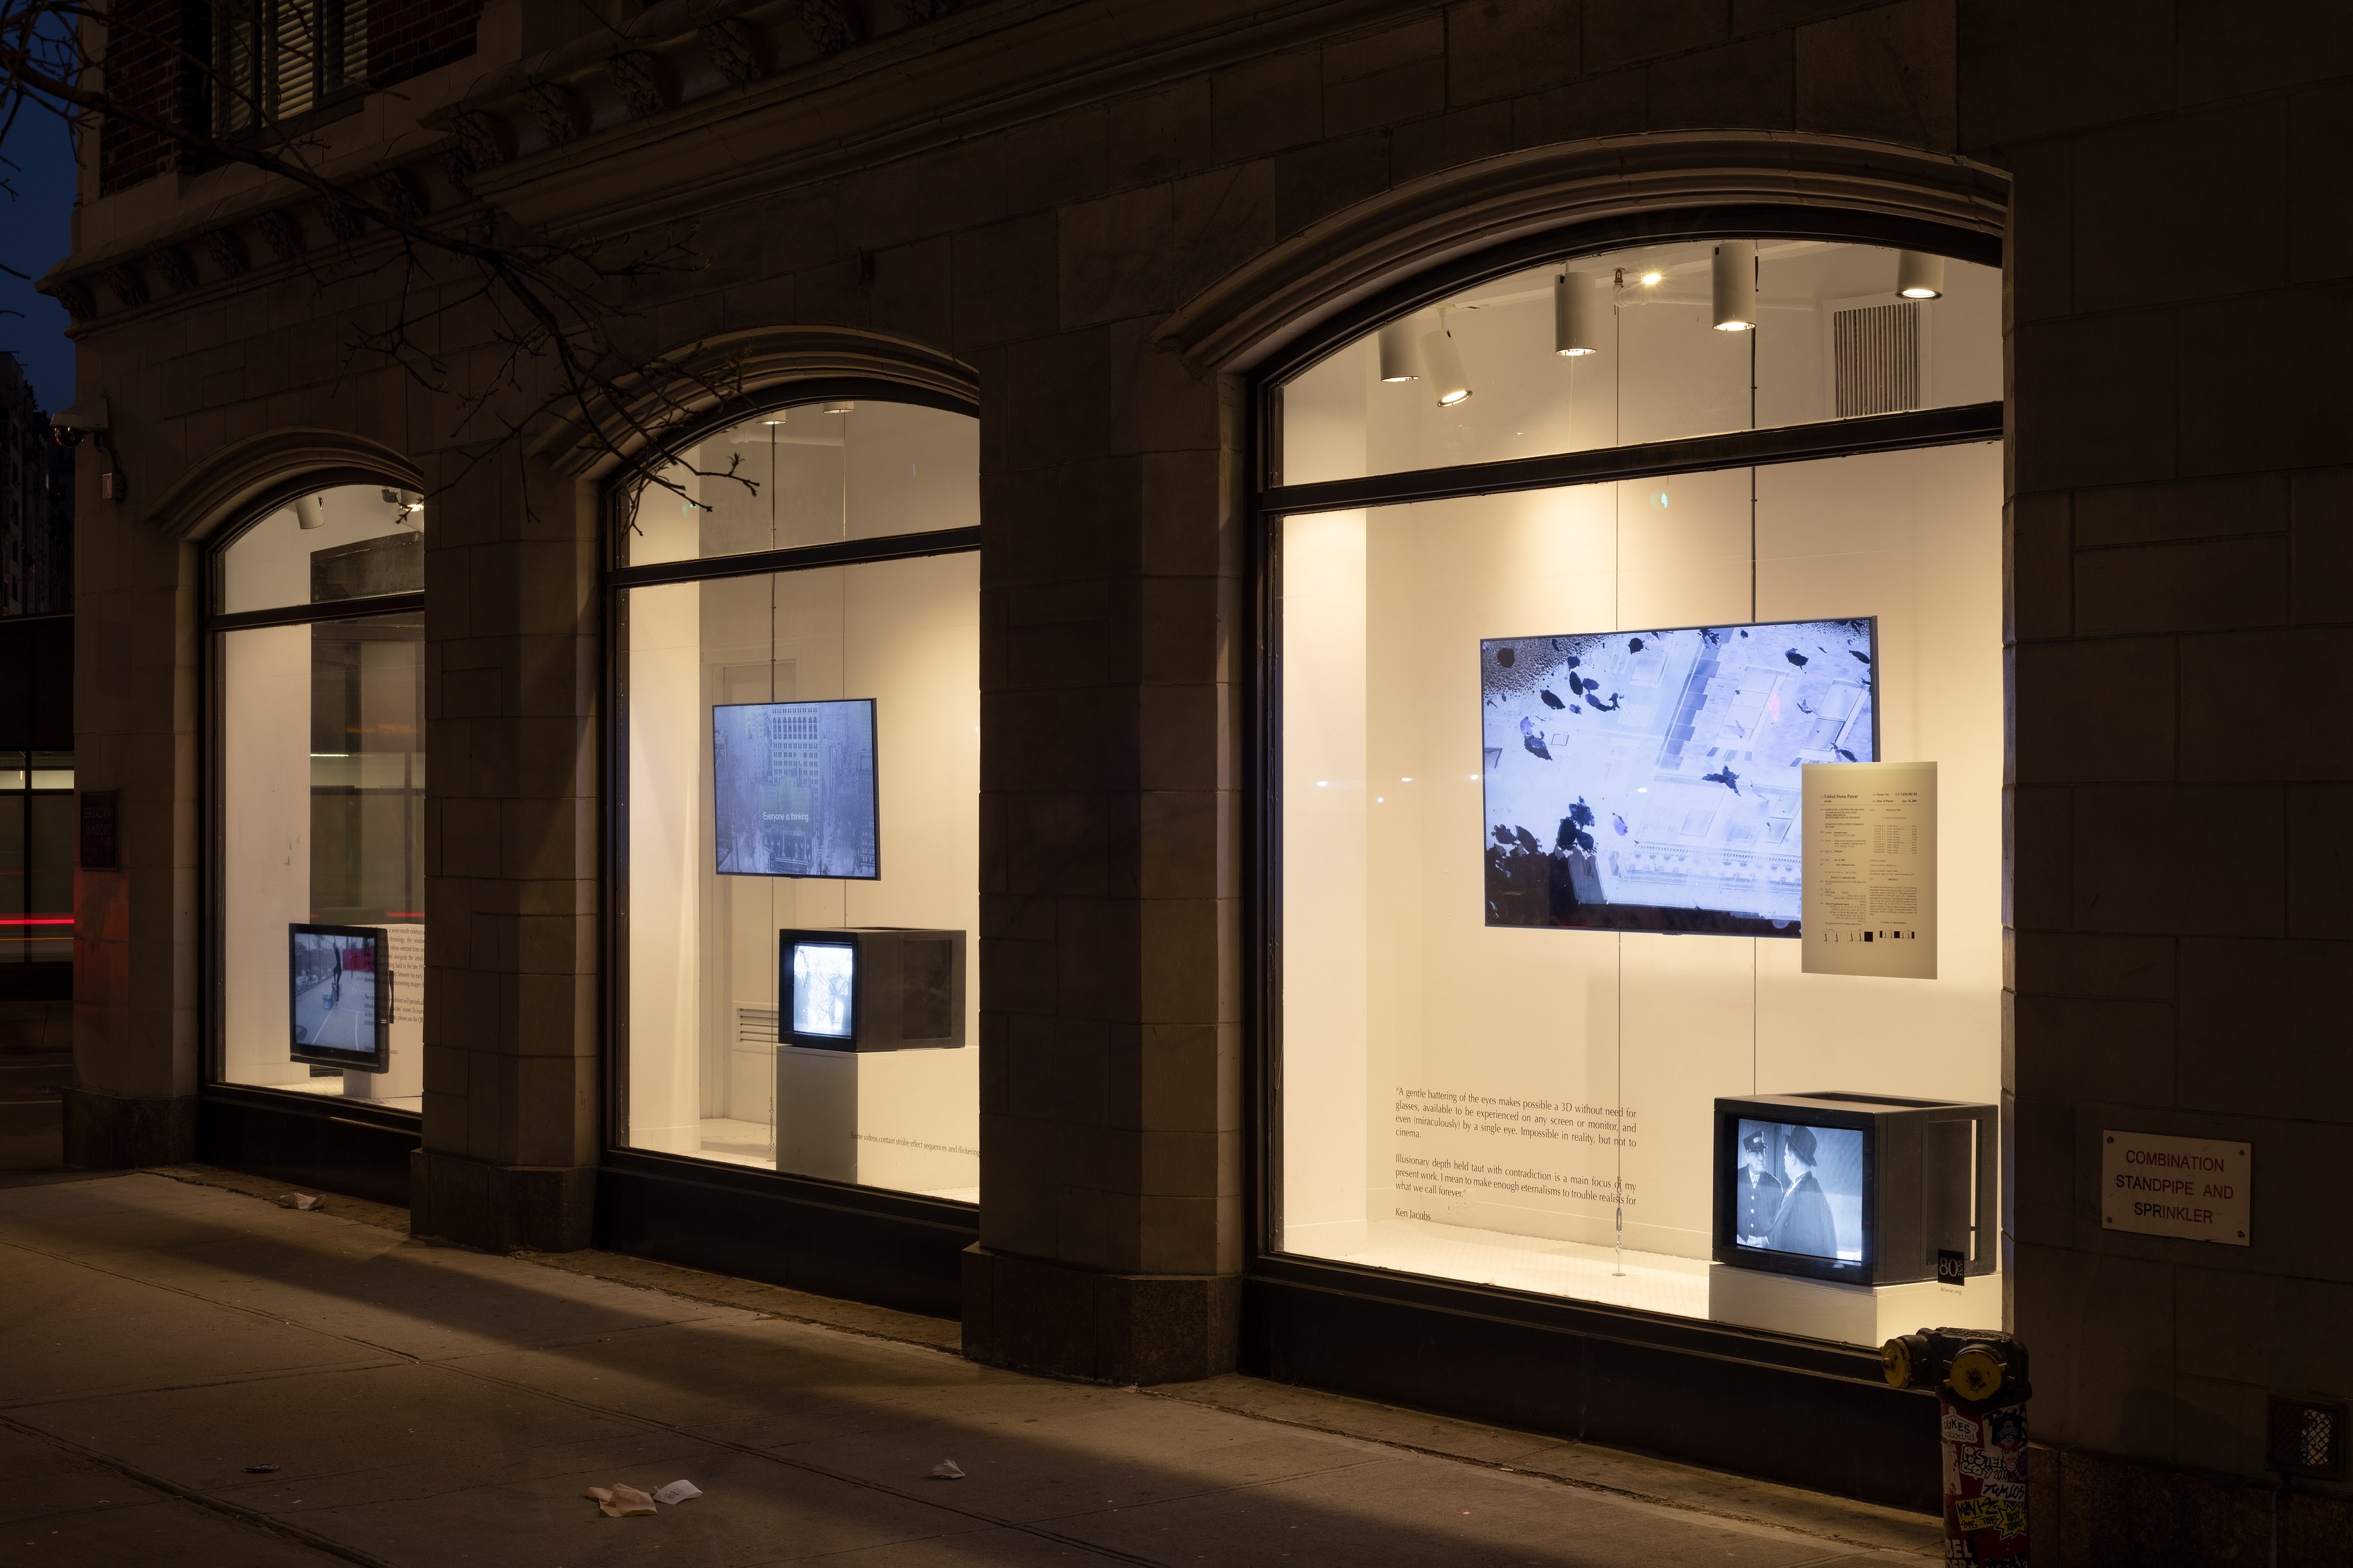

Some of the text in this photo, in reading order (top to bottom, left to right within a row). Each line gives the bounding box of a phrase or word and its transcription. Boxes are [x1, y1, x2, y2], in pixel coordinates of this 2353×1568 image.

[85, 807, 114, 818] BROADWAY
[763, 812, 809, 822] Everyone is thinking.
[86, 823, 112, 835] WINDOWS
[1396, 1087, 1404, 1096] “A
[1406, 1089, 1426, 1099] gentle
[1428, 1089, 1457, 1104] battering
[1460, 1092, 1467, 1102] of
[1468, 1094, 1479, 1103] the
[1482, 1097, 1497, 1106] eyes
[1499, 1097, 1521, 1106] makes
[1523, 1100, 1552, 1110] possible
[1562, 1102, 1572, 1112] 3D
[1575, 1104, 1603, 1114] without
[1605, 1108, 1624, 1116] need
[1626, 1108, 1636, 1118] for
[1396, 1100, 1420, 1112] glasses,
[1423, 1104, 1452, 1114] available
[1455, 1107, 1462, 1115] to
[1465, 1107, 1474, 1116] be
[1477, 1110, 1519, 1120] experienced
[1535, 1116, 1547, 1126] any
[1551, 1118, 1573, 1126] screen
[1588, 1120, 1618, 1132] monitor,
[1622, 1123, 1636, 1132] and
[1396, 1128, 1421, 1138] cinema.
[1414, 1115, 1460, 1132] (miraculously)
[1463, 1120, 1471, 1132] by
[1481, 1122, 1501, 1135] single
[1504, 1127, 1517, 1137] eye.
[1521, 1126, 1558, 1139] Impossible
[1562, 1130, 1568, 1140] in
[1572, 1132, 1595, 1145] reality,
[1599, 1134, 1611, 1144] but
[850, 1131, 980, 1158] Some videos contain strobe effect sequences and flickering
[2126, 1150, 2224, 1172] COMBINATION
[1396, 1154, 1429, 1169] Illusionary
[1432, 1158, 1451, 1171] depth
[1454, 1161, 1469, 1171] held
[1472, 1164, 1484, 1172] taut
[1487, 1165, 1502, 1174] with
[1505, 1169, 1552, 1180] contradiction
[1555, 1172, 1560, 1181] is
[1570, 1175, 1589, 1184] main
[1592, 1176, 1611, 1187] focus
[1614, 1179, 1622, 1188] of
[1625, 1183, 1636, 1192] my
[1396, 1170, 1419, 1179] present
[1421, 1171, 1439, 1181] work.
[1441, 1173, 1443, 1182] I
[1466, 1177, 1472, 1185] to
[1474, 1178, 1492, 1187] make
[1494, 1182, 1519, 1192] enough
[1521, 1184, 1561, 1195] eternalisms
[1563, 1188, 1570, 1196] to
[1572, 1190, 1597, 1200] trouble
[1599, 1192, 1624, 1202] realists
[1626, 1194, 1636, 1204] for
[1396, 1181, 1411, 1191] what
[1425, 1185, 1437, 1194] call
[1439, 1186, 1466, 1197] forever.”
[2116, 1174, 2233, 1199] STANDPIPE AND
[1396, 1208, 1431, 1221] Ken Jacobs
[2134, 1202, 2213, 1224] SPRINKLER
[1939, 1257, 1958, 1277] 80
[1944, 1419, 1970, 1434] DUKES
